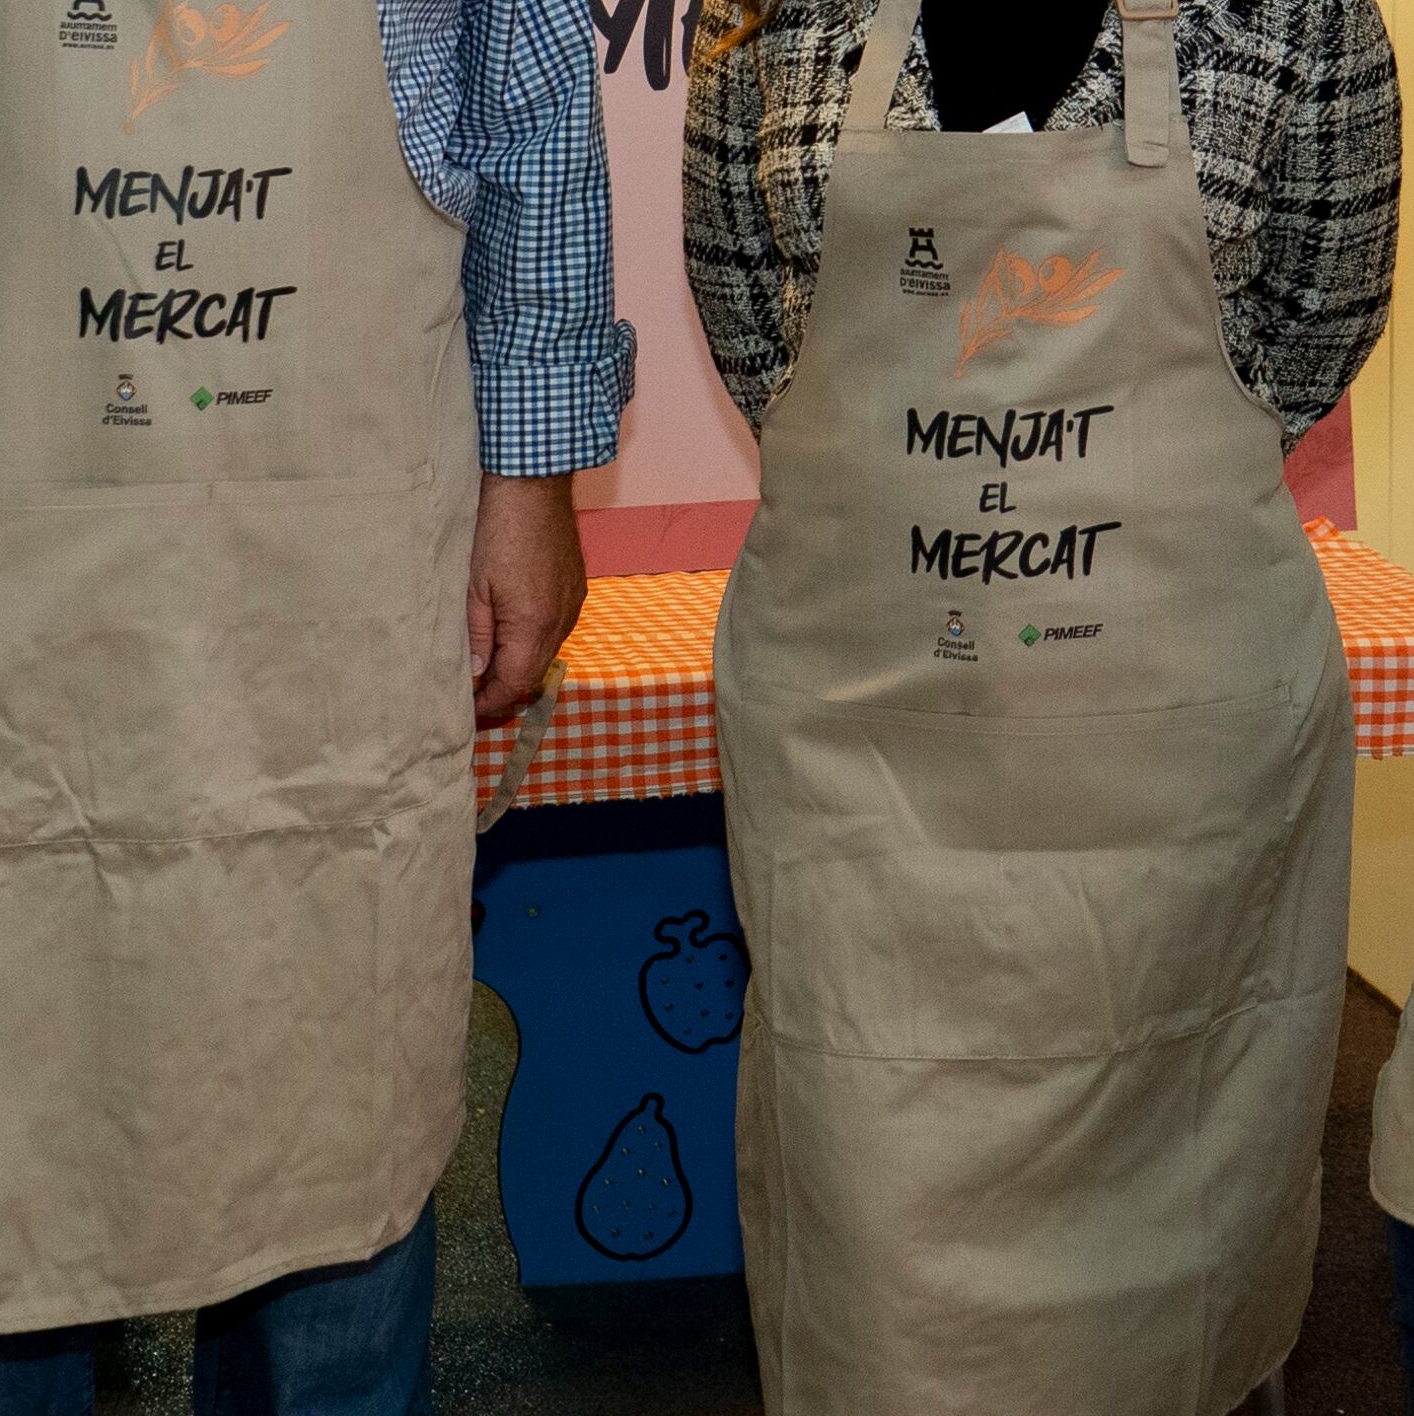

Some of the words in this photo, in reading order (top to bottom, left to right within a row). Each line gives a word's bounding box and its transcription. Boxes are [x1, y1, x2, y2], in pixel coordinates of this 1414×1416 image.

[74, 165, 293, 225] MENJA'T
[155, 239, 194, 271] EL
[78, 285, 298, 345] MERCAT
[106, 403, 148, 415] Consell
[216, 389, 274, 406] PIMEEF
[102, 415, 152, 427] d'Eivissa
[905, 404, 1115, 468] MENJA'T
[979, 481, 1017, 514] EL
[910, 521, 1123, 585] MERCAT
[937, 636, 976, 652] Consell
[1043, 623, 1104, 642] PIMEEF
[933, 647, 979, 663] d'Eivissa
